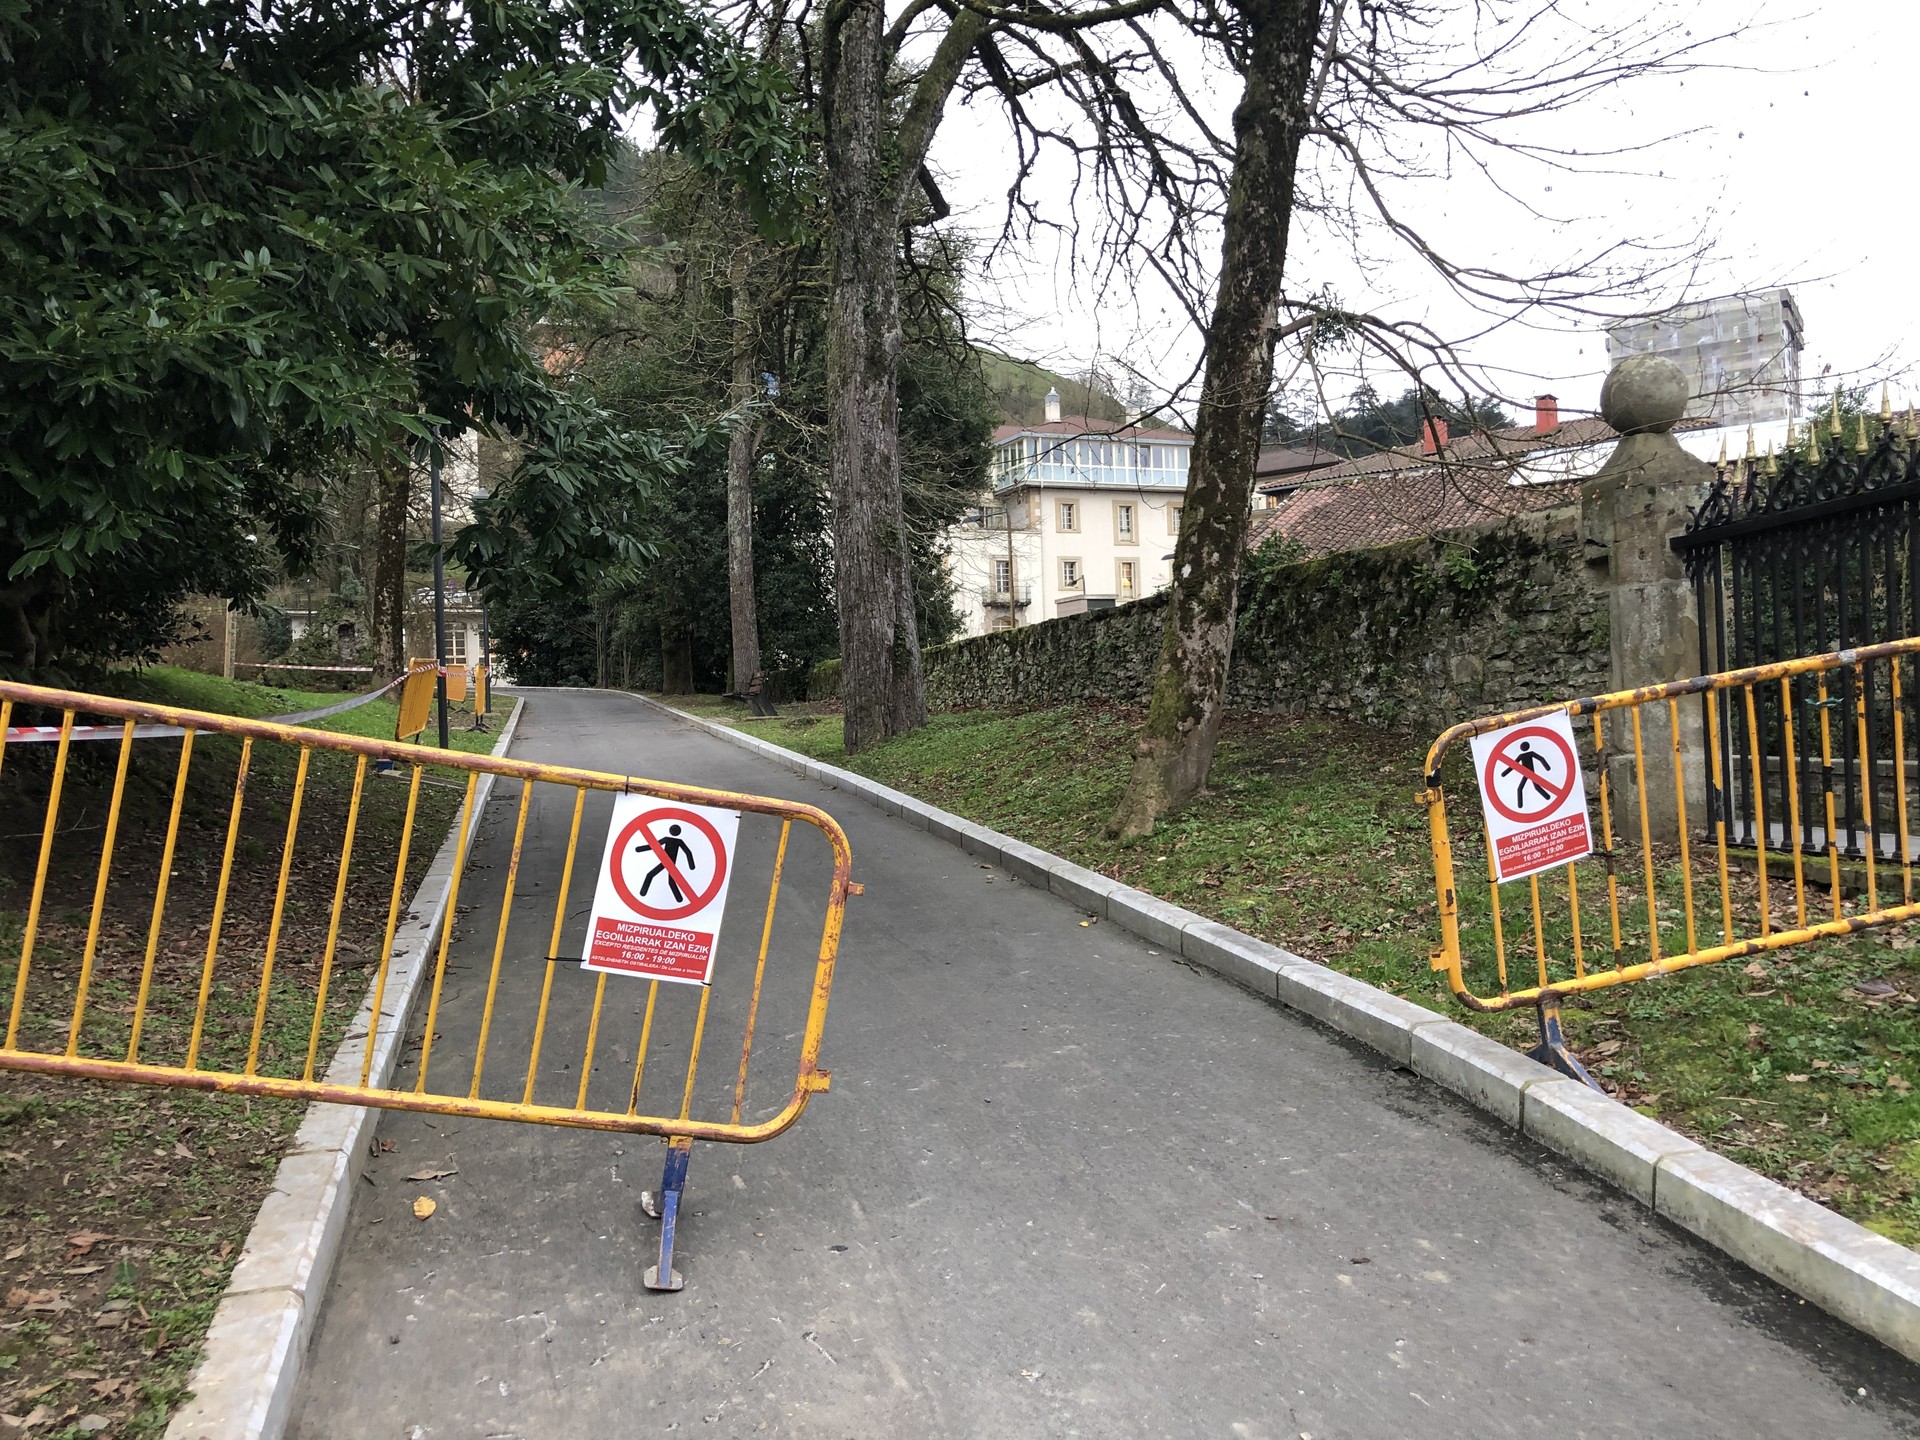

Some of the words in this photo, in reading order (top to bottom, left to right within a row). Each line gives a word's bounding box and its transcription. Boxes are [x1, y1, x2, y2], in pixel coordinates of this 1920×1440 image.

[1499, 833, 1549, 856] EGOILIARRAK
[1550, 828, 1567, 840] IZAN
[1568, 823, 1585, 834] EZIK
[1512, 819, 1571, 843] MIZPIRUALDEKO
[1523, 851, 1541, 862] 16:00
[1546, 843, 1564, 855] 19:00
[595, 930, 662, 948] EGOILIARRAK
[663, 940, 686, 951] IZAN
[687, 943, 710, 954] EZIK
[616, 922, 695, 942] MIZPIRUALDEKO
[593, 939, 621, 949] EXCEPTO
[621, 944, 659, 954] RESIDENTES
[668, 951, 708, 961] MIZPIRUALDE
[621, 950, 645, 961] 16:00
[652, 954, 676, 965] 19:00
